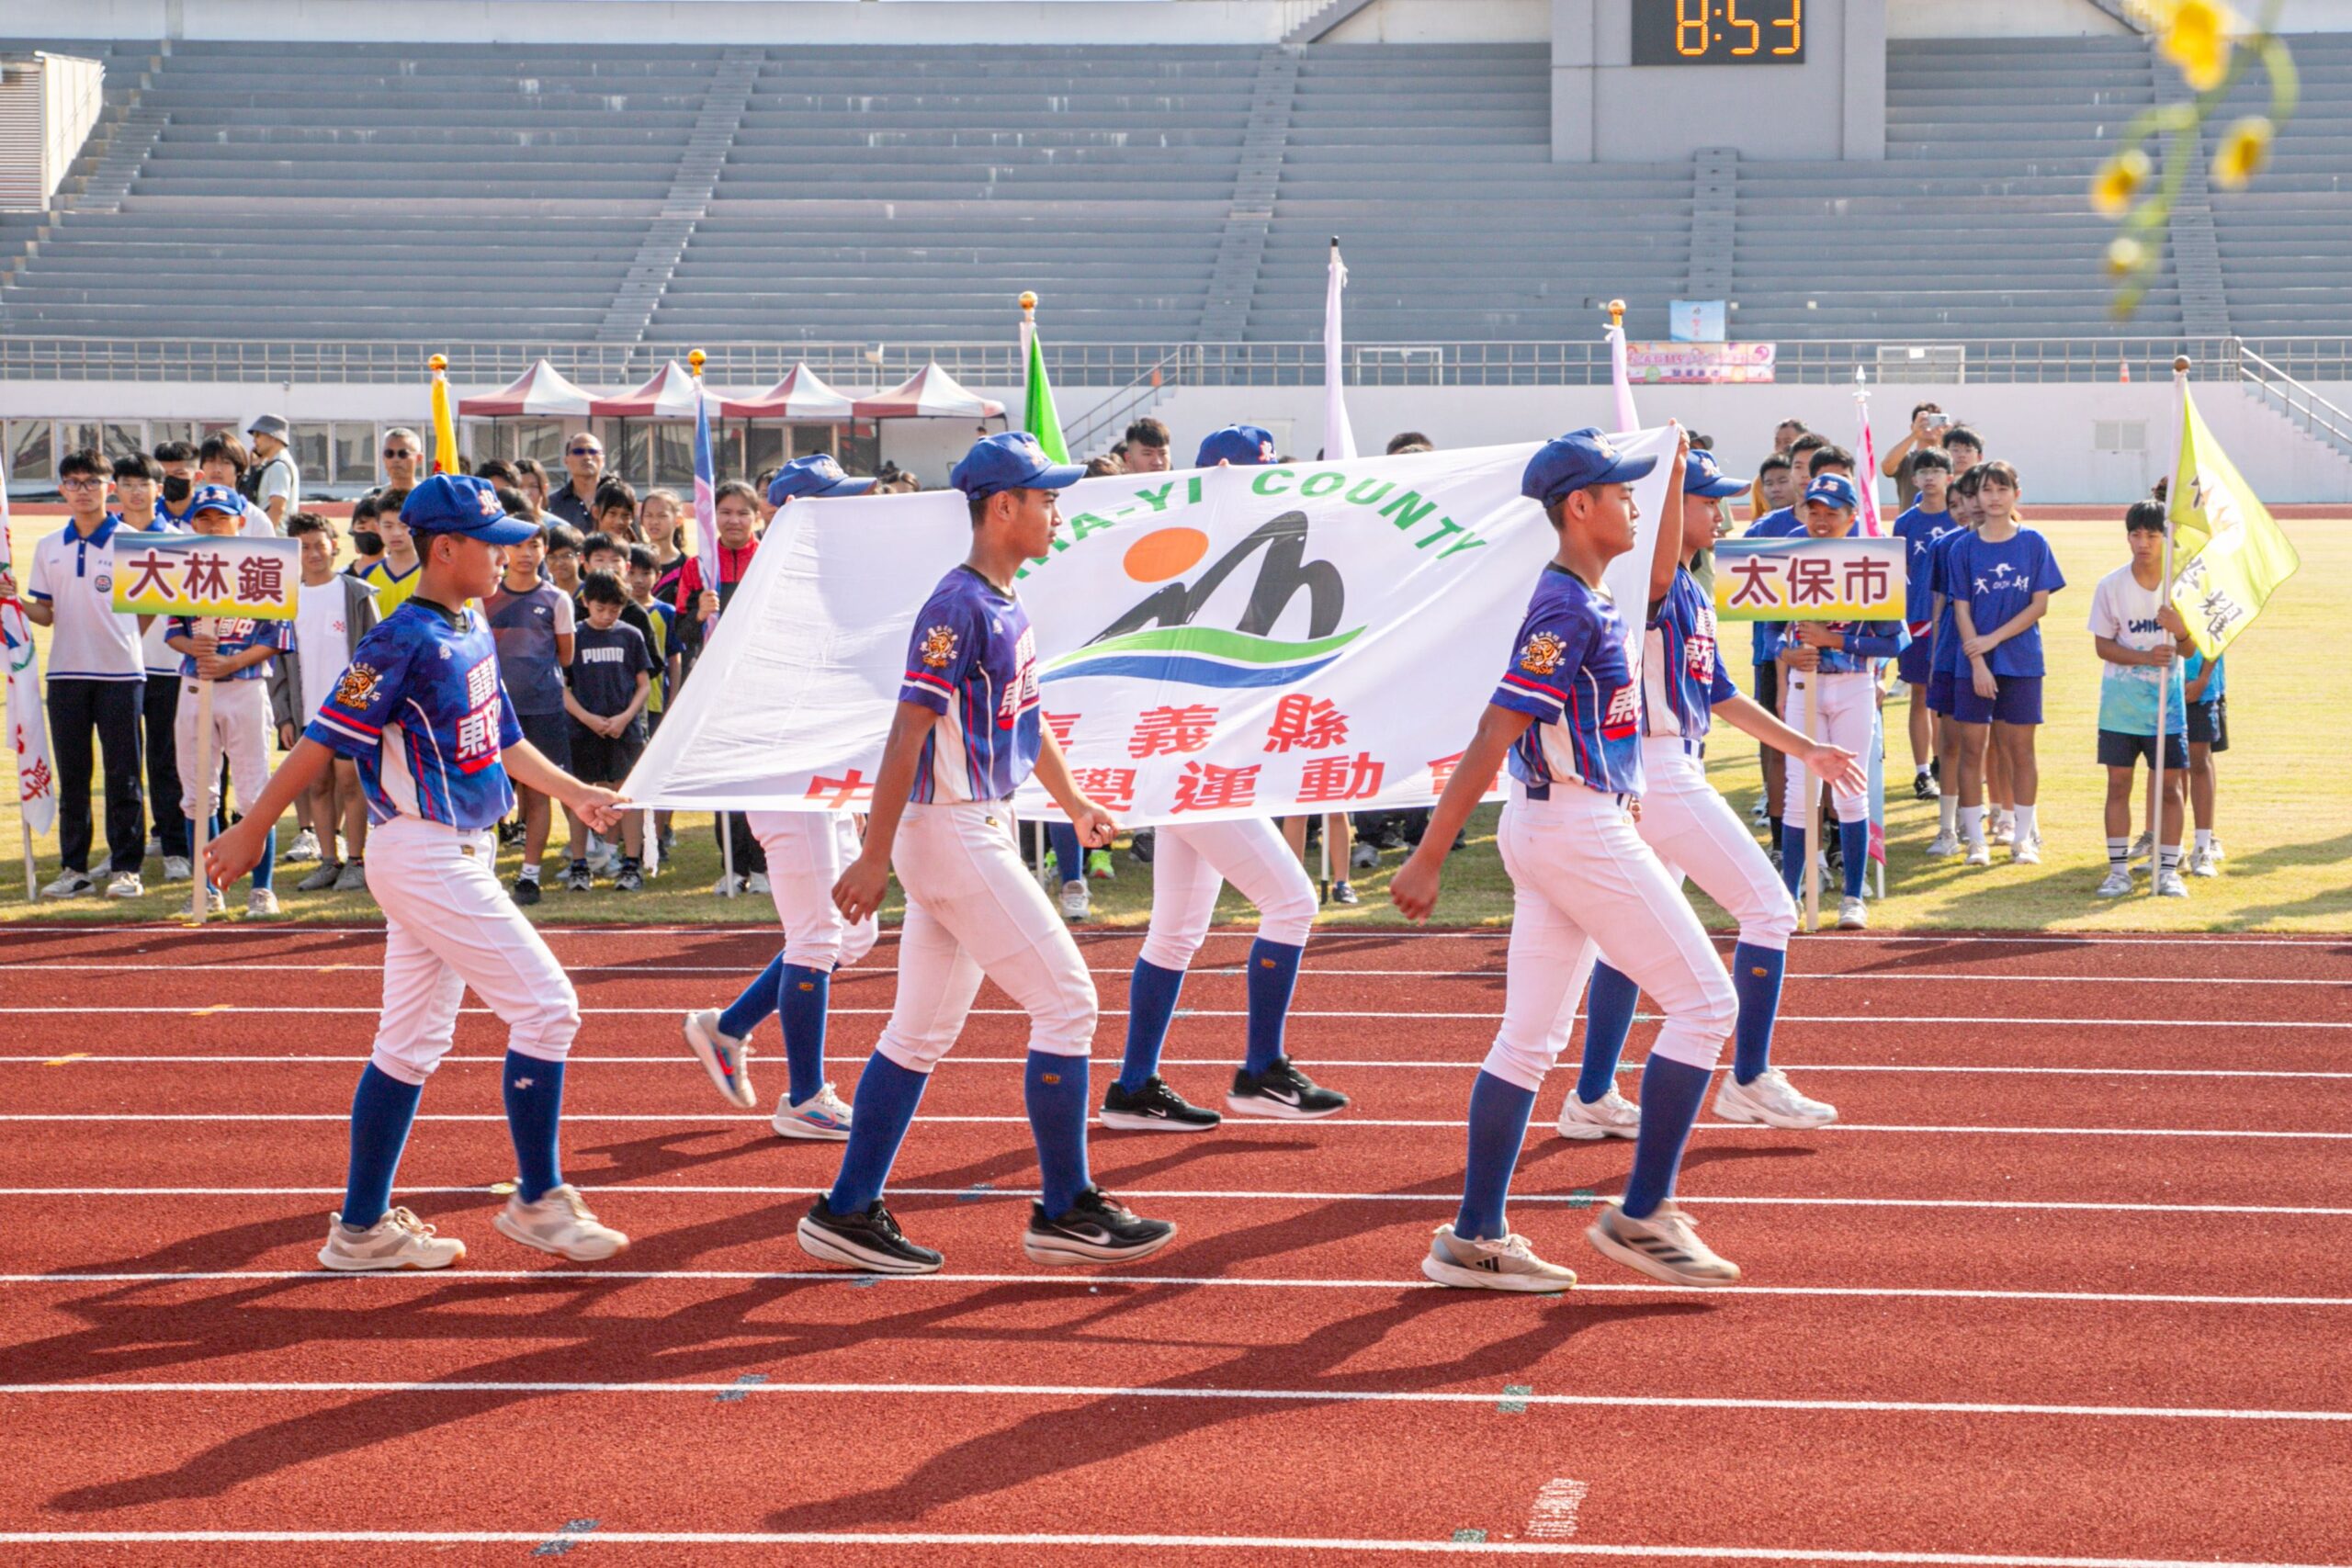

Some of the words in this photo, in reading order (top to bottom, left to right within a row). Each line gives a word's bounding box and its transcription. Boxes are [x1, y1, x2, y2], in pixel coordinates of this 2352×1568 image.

[1676, 0, 1801, 56] 8:53
[1015, 477, 1202, 580] A-YI
[1251, 468, 1487, 560] COUNTY
[1731, 556, 1890, 604] 太保市
[582, 647, 625, 664] PUMA
